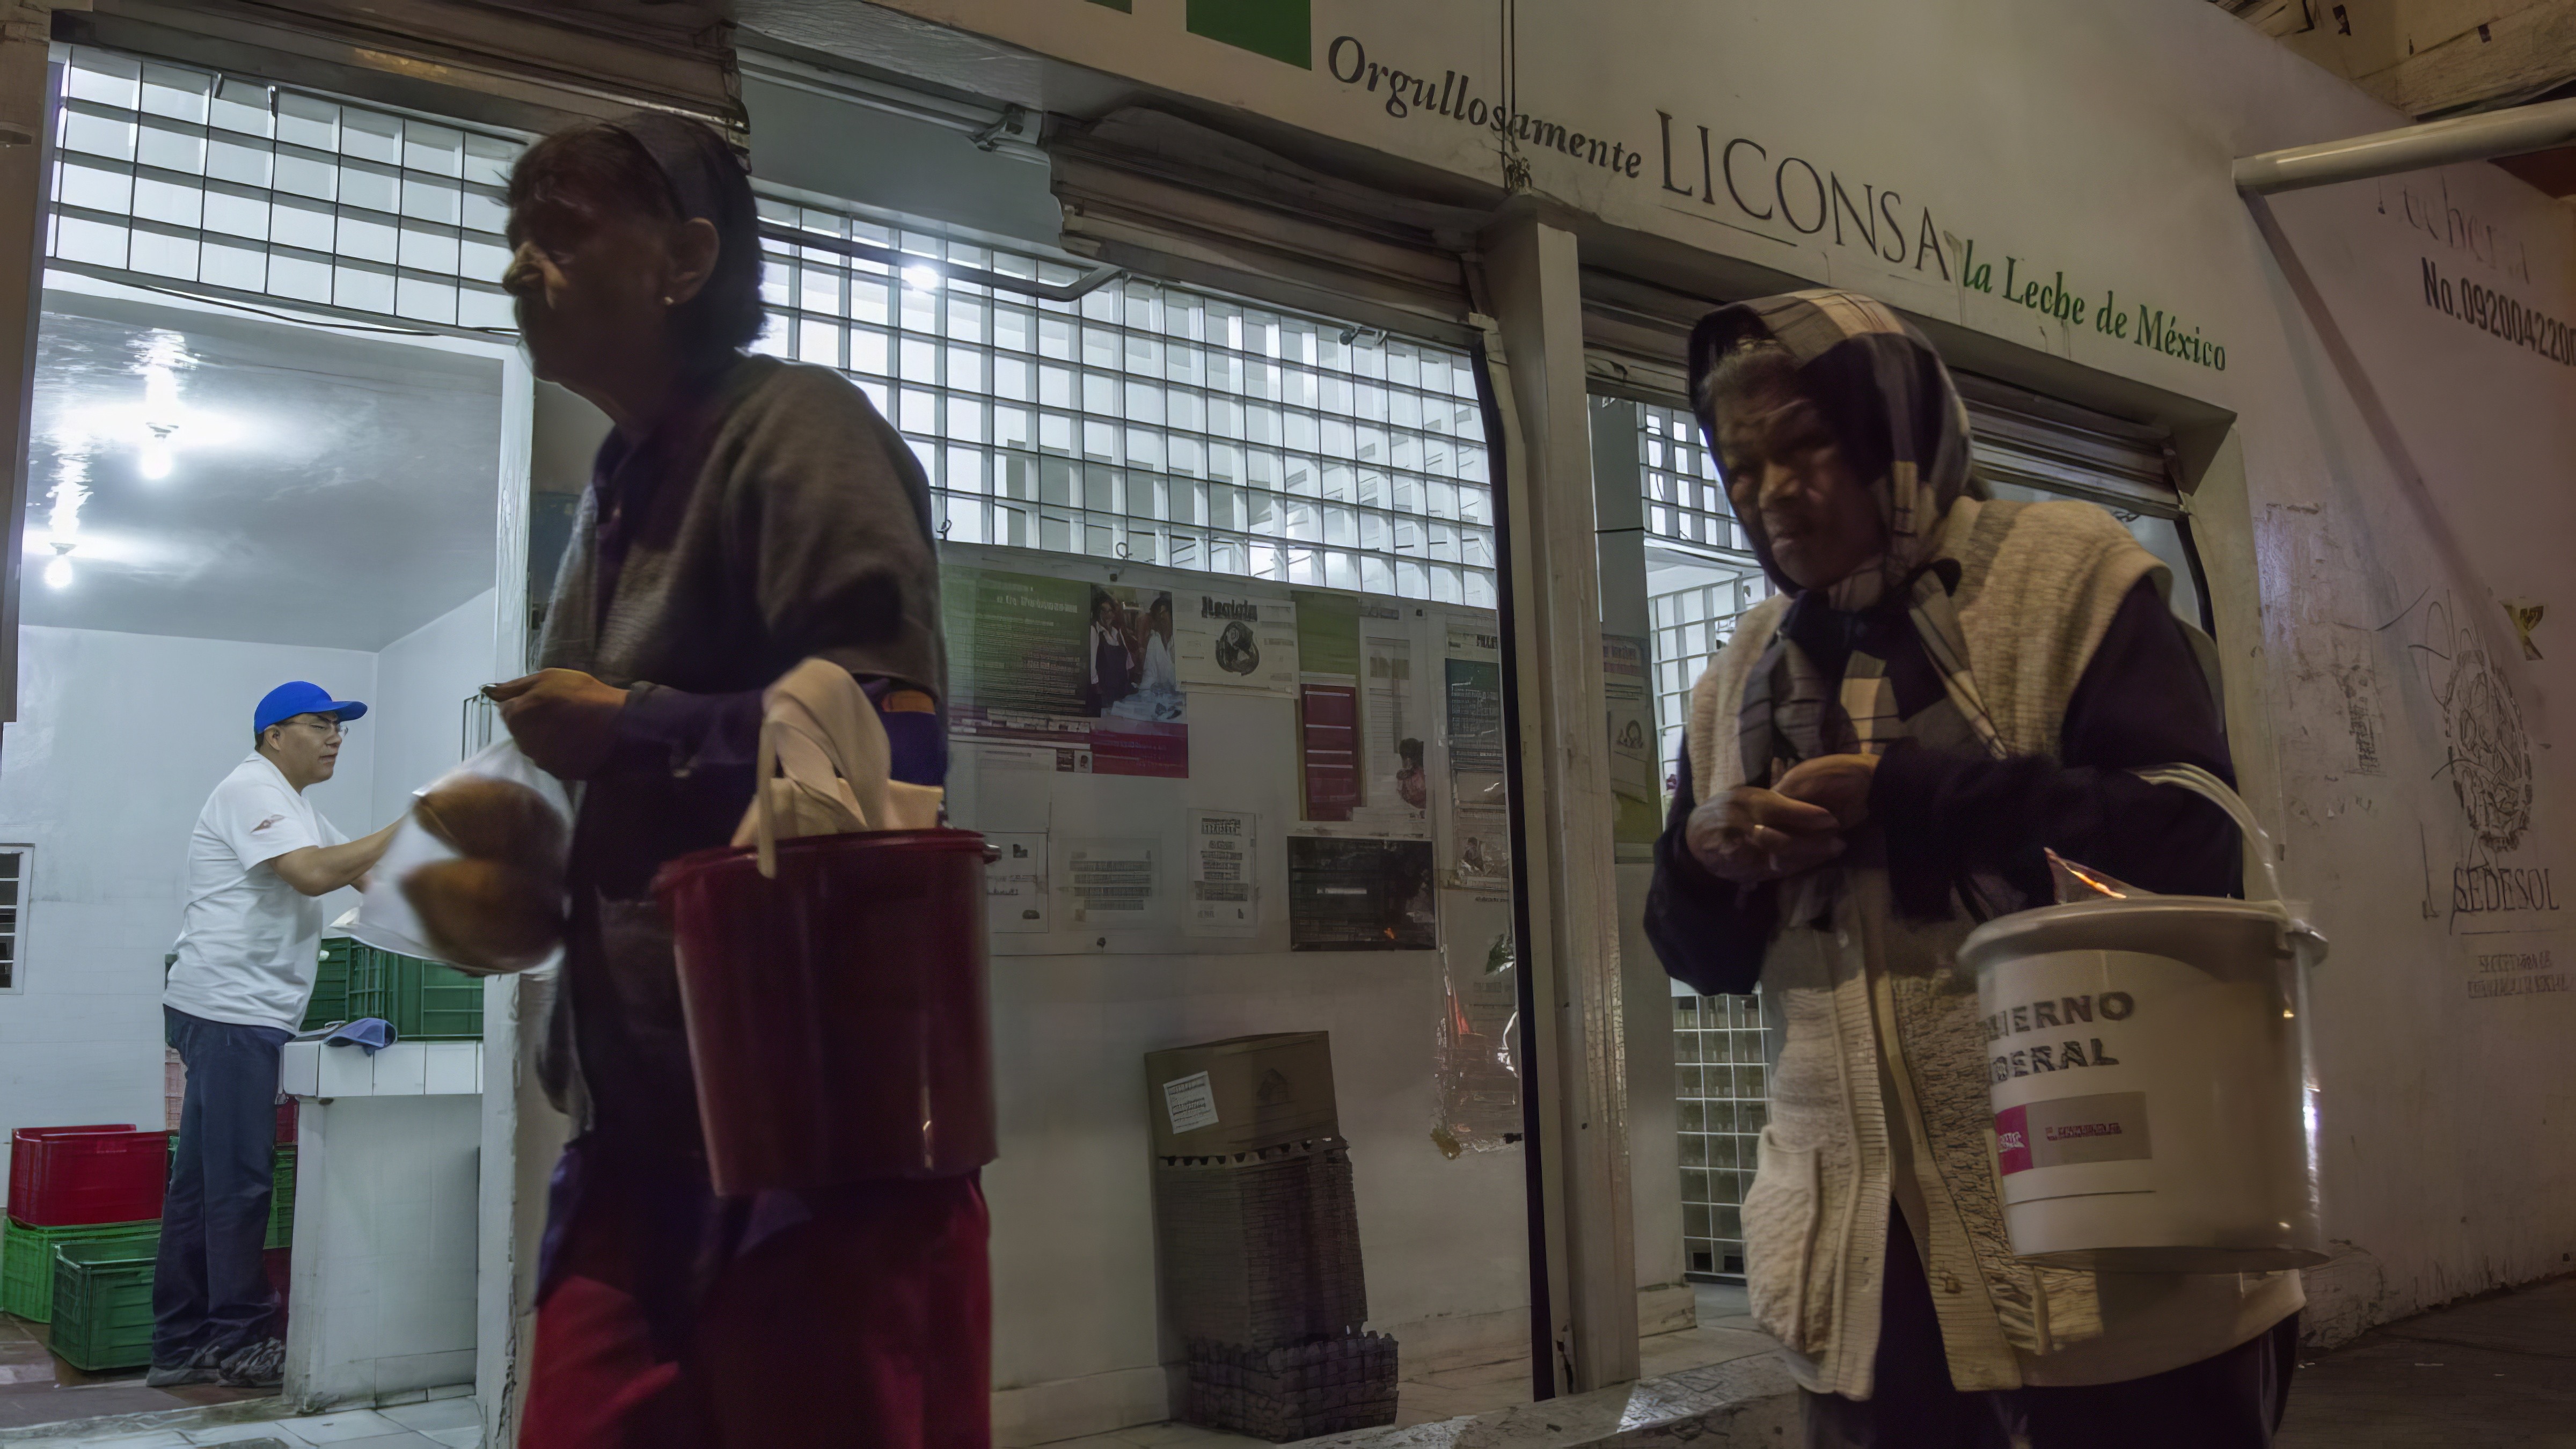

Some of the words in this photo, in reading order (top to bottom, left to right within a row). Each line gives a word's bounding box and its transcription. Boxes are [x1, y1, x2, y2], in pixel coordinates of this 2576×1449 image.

[1327, 35, 1642, 179] Orgullosamente
[1656, 108, 1951, 282] LICONSA
[1962, 239, 1993, 294] la
[2001, 255, 2085, 325] Leche
[2096, 290, 2127, 340] de
[2133, 304, 2227, 371] México
[2453, 866, 2560, 913] SEDESOL
